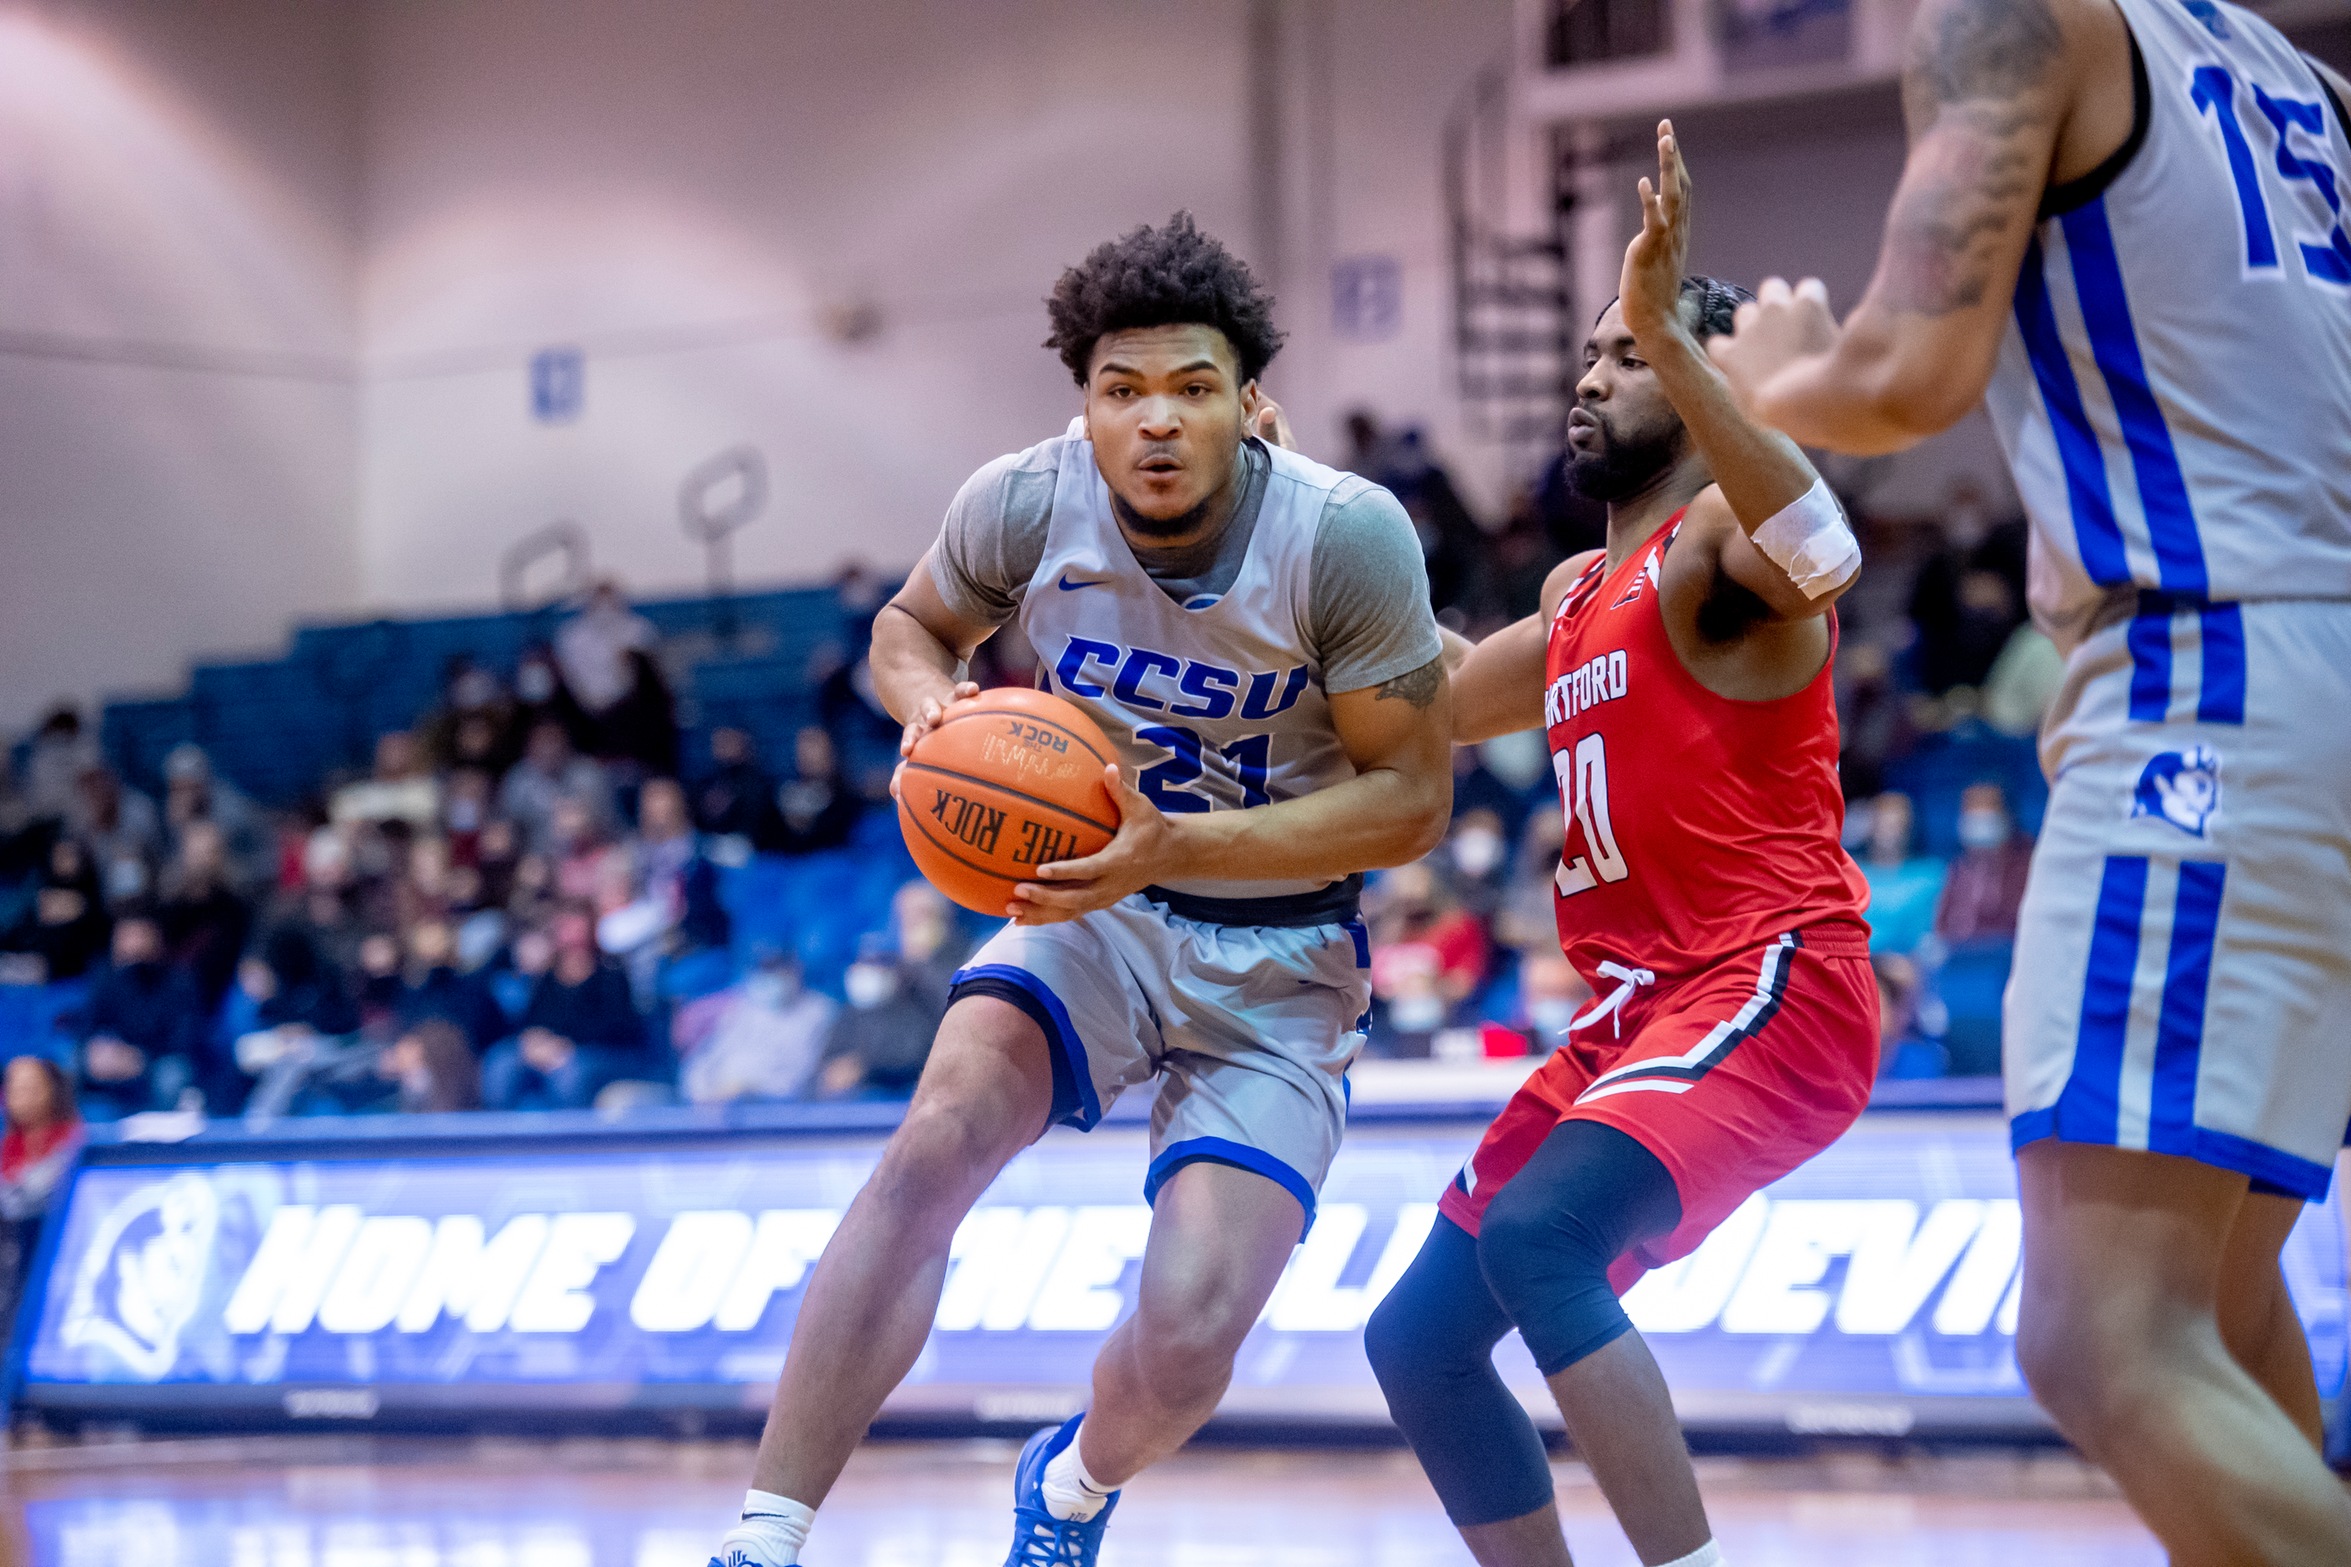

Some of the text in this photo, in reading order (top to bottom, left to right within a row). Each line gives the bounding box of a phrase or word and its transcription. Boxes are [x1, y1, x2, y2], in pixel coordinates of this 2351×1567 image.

[2188, 62, 2351, 292] 15
[1055, 633, 1310, 720] CCSU
[1007, 721, 1069, 754] ROCK
[1131, 721, 1275, 814] 21
[930, 789, 1007, 855] ROCK
[1552, 732, 1628, 898] 20
[223, 1203, 637, 1335] HOME
[630, 1207, 847, 1332] OF
[935, 1205, 1155, 1332] HE
[1618, 1195, 2022, 1335] DEVI
